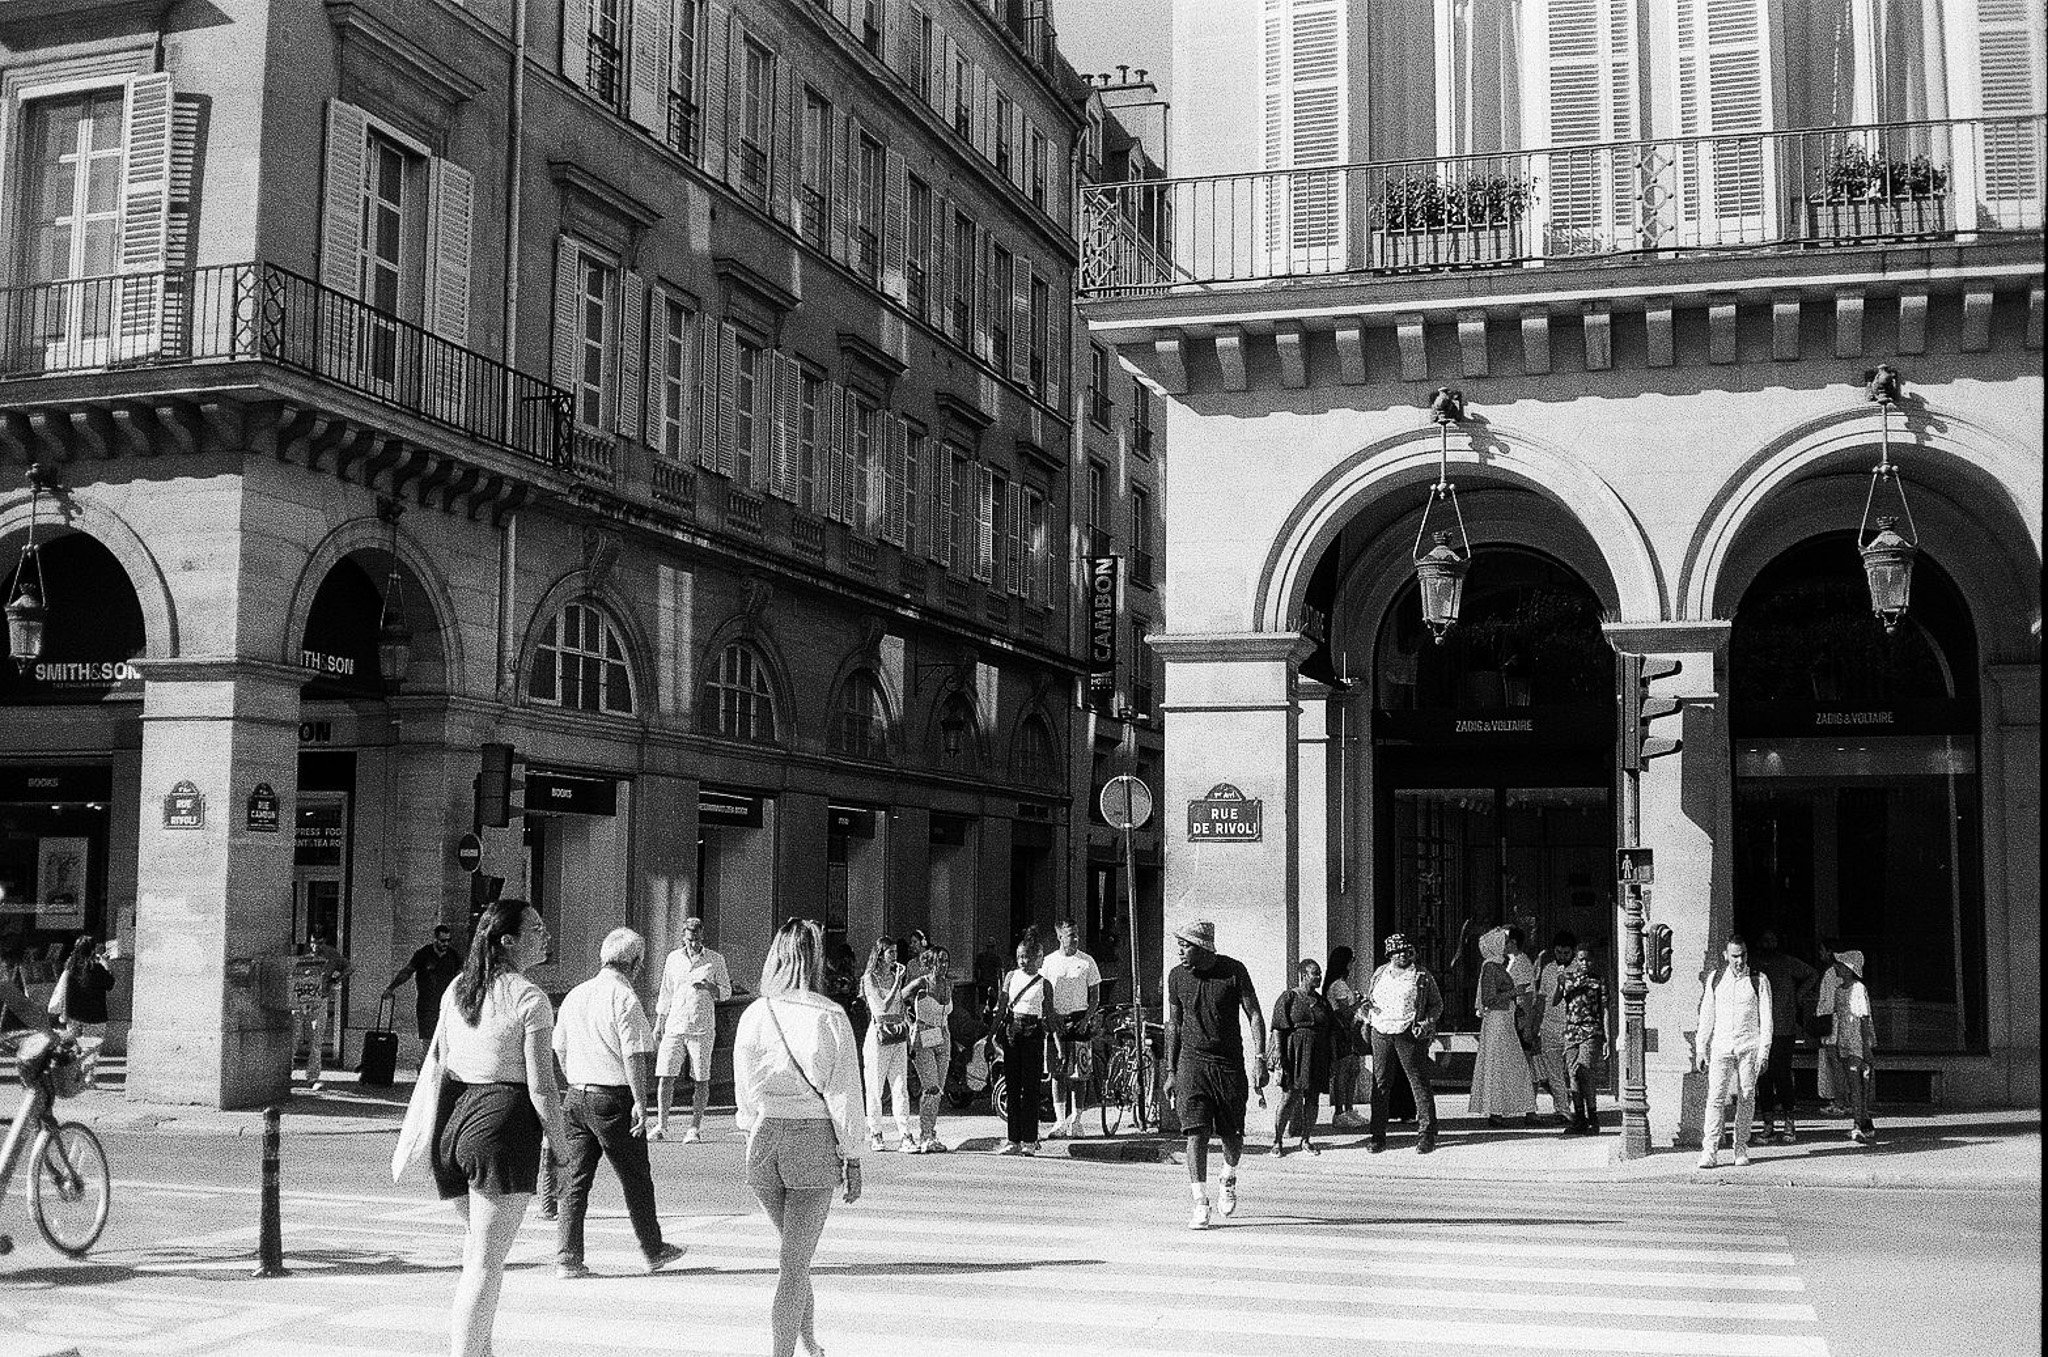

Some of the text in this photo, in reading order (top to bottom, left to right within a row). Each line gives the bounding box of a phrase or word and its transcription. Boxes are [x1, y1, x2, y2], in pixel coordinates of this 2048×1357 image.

[1094, 558, 1114, 661] CAMBON
[28, 778, 59, 788] BOOKS
[551, 787, 573, 799] BOOKS
[175, 799, 194, 809] RUE
[1211, 808, 1239, 820] RUE
[1193, 822, 1257, 835] DE RIVOLI
